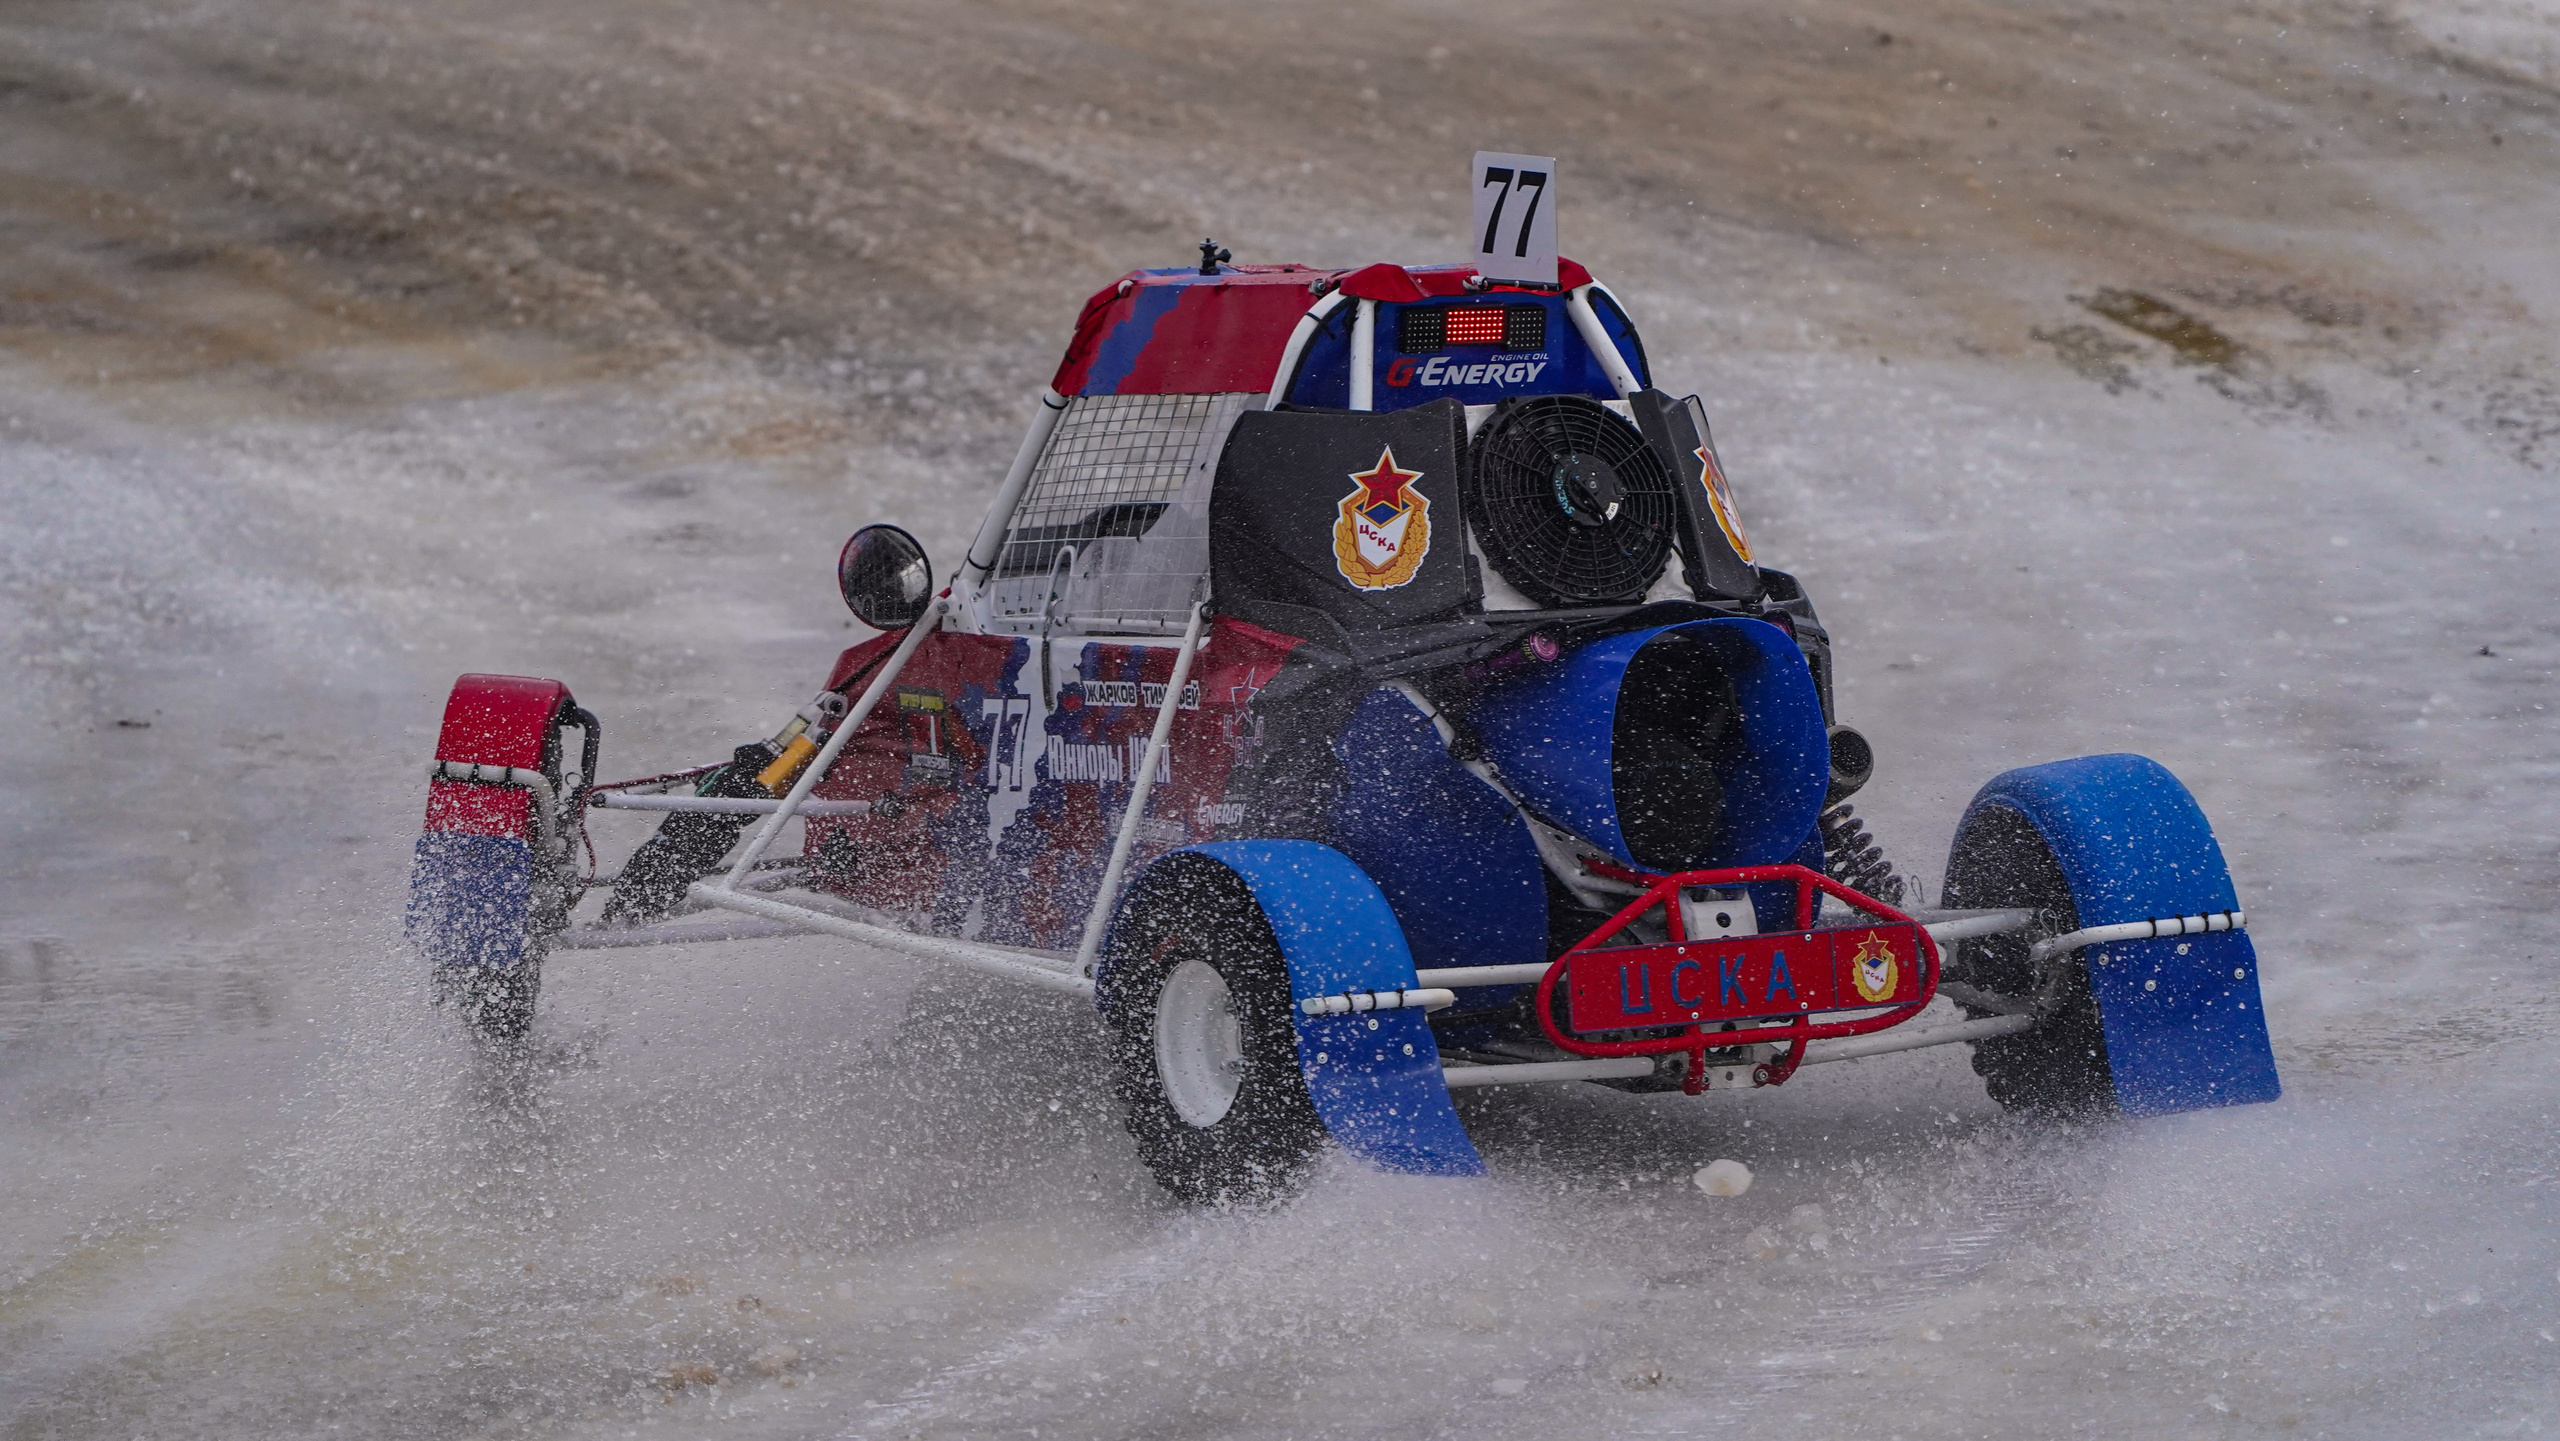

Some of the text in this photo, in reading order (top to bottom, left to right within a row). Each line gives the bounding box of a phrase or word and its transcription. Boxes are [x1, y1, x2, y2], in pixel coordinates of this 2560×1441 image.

[1482, 166, 1547, 257] 77
[1491, 354, 1530, 362] ENGINE
[1359, 524, 1396, 551] ЦСКА
[1085, 683, 1136, 704] ЖАРКОВ
[982, 695, 1030, 791] 77
[1048, 735, 1122, 788] Юниоры
[1618, 950, 1797, 1014] ЦСКА
[1865, 969, 1885, 983] ЦСКА
